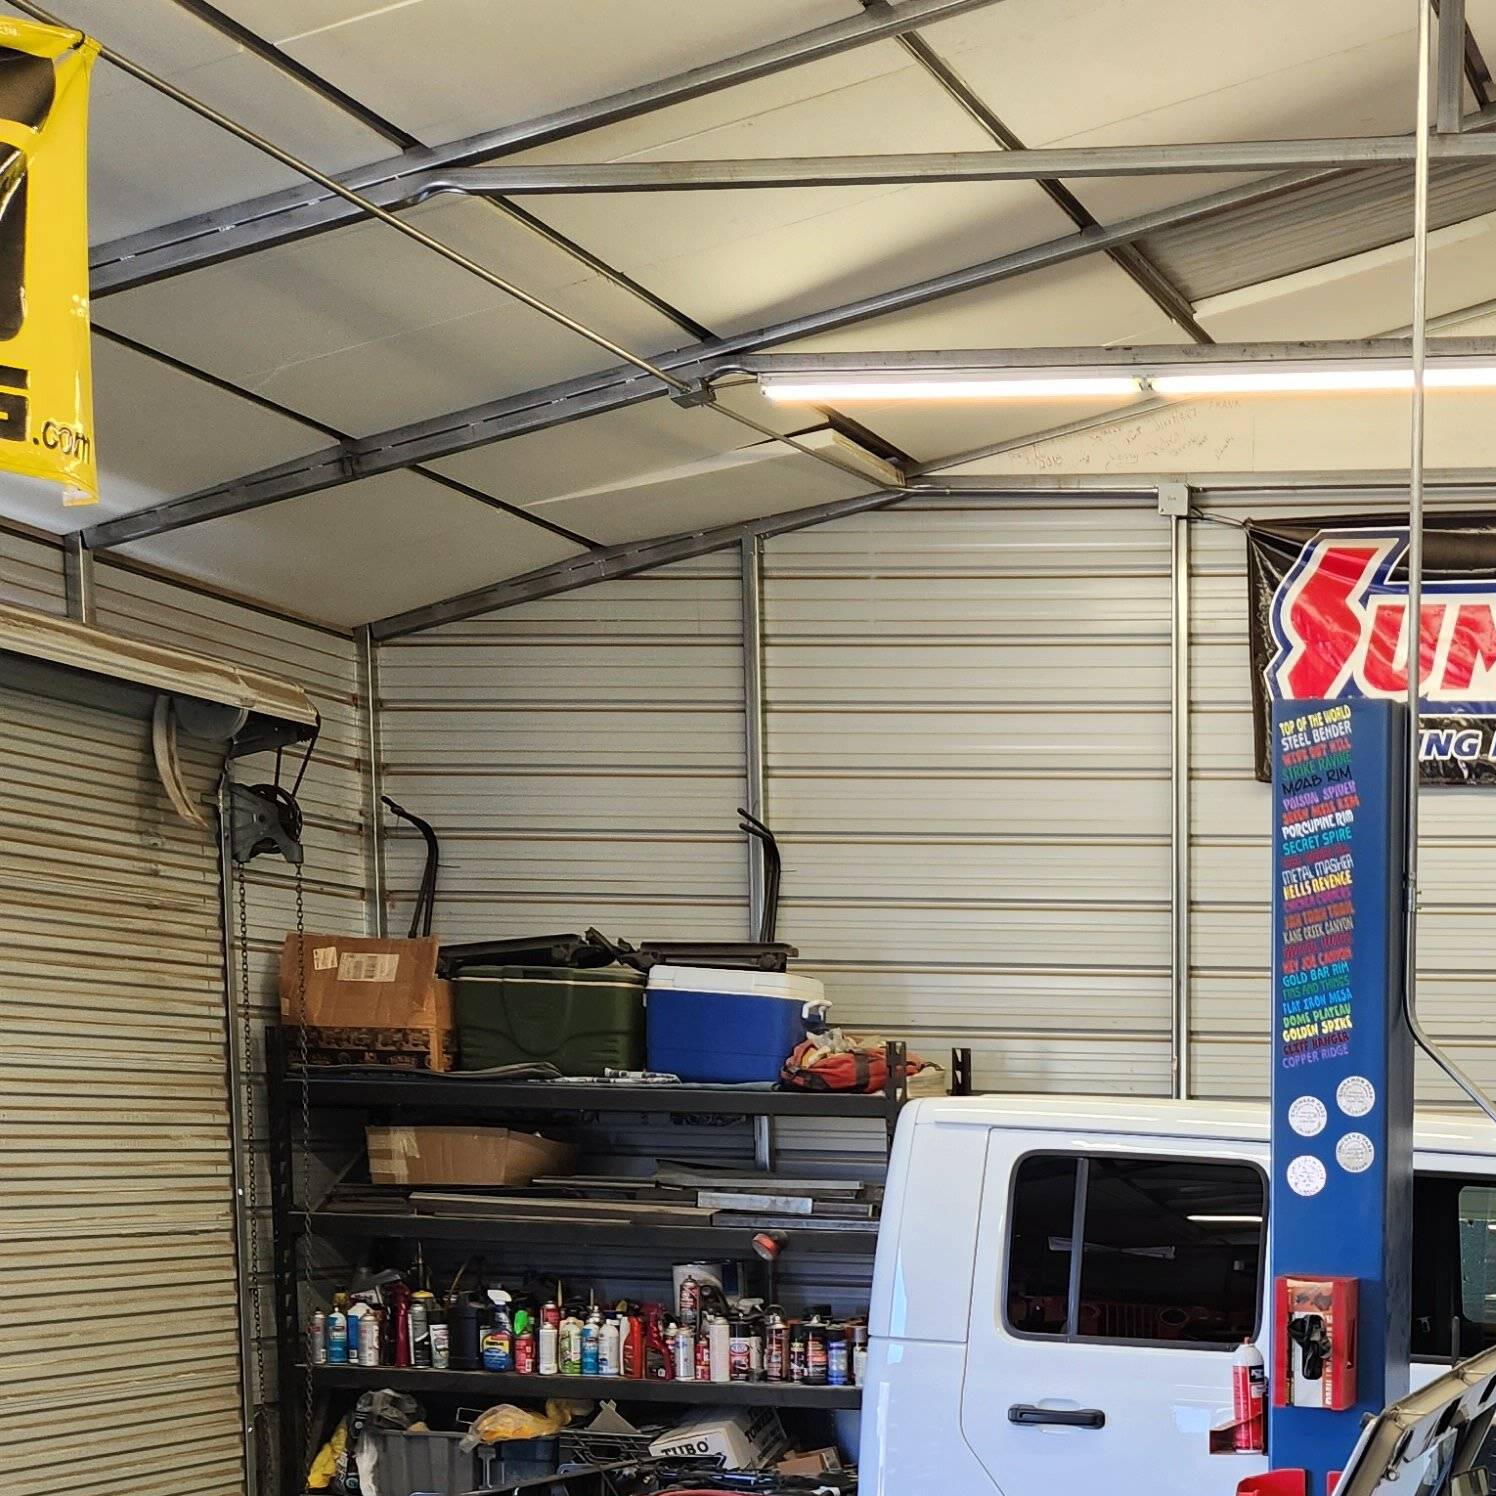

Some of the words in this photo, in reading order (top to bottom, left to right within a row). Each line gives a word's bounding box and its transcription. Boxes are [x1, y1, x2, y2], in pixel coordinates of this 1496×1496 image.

[1279, 721, 1295, 737] TOP
[1296, 716, 1307, 732] OF
[1307, 711, 1323, 728] THE
[1323, 704, 1351, 724] WORLD
[1281, 732, 1311, 751] STEEL
[1312, 720, 1352, 743] BENDER
[1281, 774, 1322, 796] MOAB
[1326, 765, 1353, 782] RIM
[1282, 790, 1319, 811] POISON
[1322, 780, 1357, 801] SPIDER
[1282, 814, 1336, 840] PORCUPINE
[1335, 810, 1354, 826] RIM
[1282, 834, 1320, 856] SECRET
[1322, 826, 1353, 846] SPIRE
[1281, 864, 1314, 886] METAL
[1314, 853, 1354, 876] MASHER
[1283, 880, 1312, 901] HELLS
[1312, 870, 1353, 893] REVENGE
[1282, 972, 1308, 988] GOLD
[1310, 966, 1330, 981] BAR
[1333, 961, 1350, 976] RIM
[1282, 998, 1302, 1015] FLAT
[1303, 994, 1326, 1011] IRON
[1328, 987, 1353, 1004] MESA
[1282, 1011, 1311, 1029] DOME
[1312, 1002, 1352, 1022] PLATEAU
[1282, 1023, 1319, 1043] GOLDEN
[1321, 1015, 1353, 1035] SPIKE
[1282, 1050, 1319, 1069] COPPER
[1321, 1044, 1349, 1061] RIDGE
